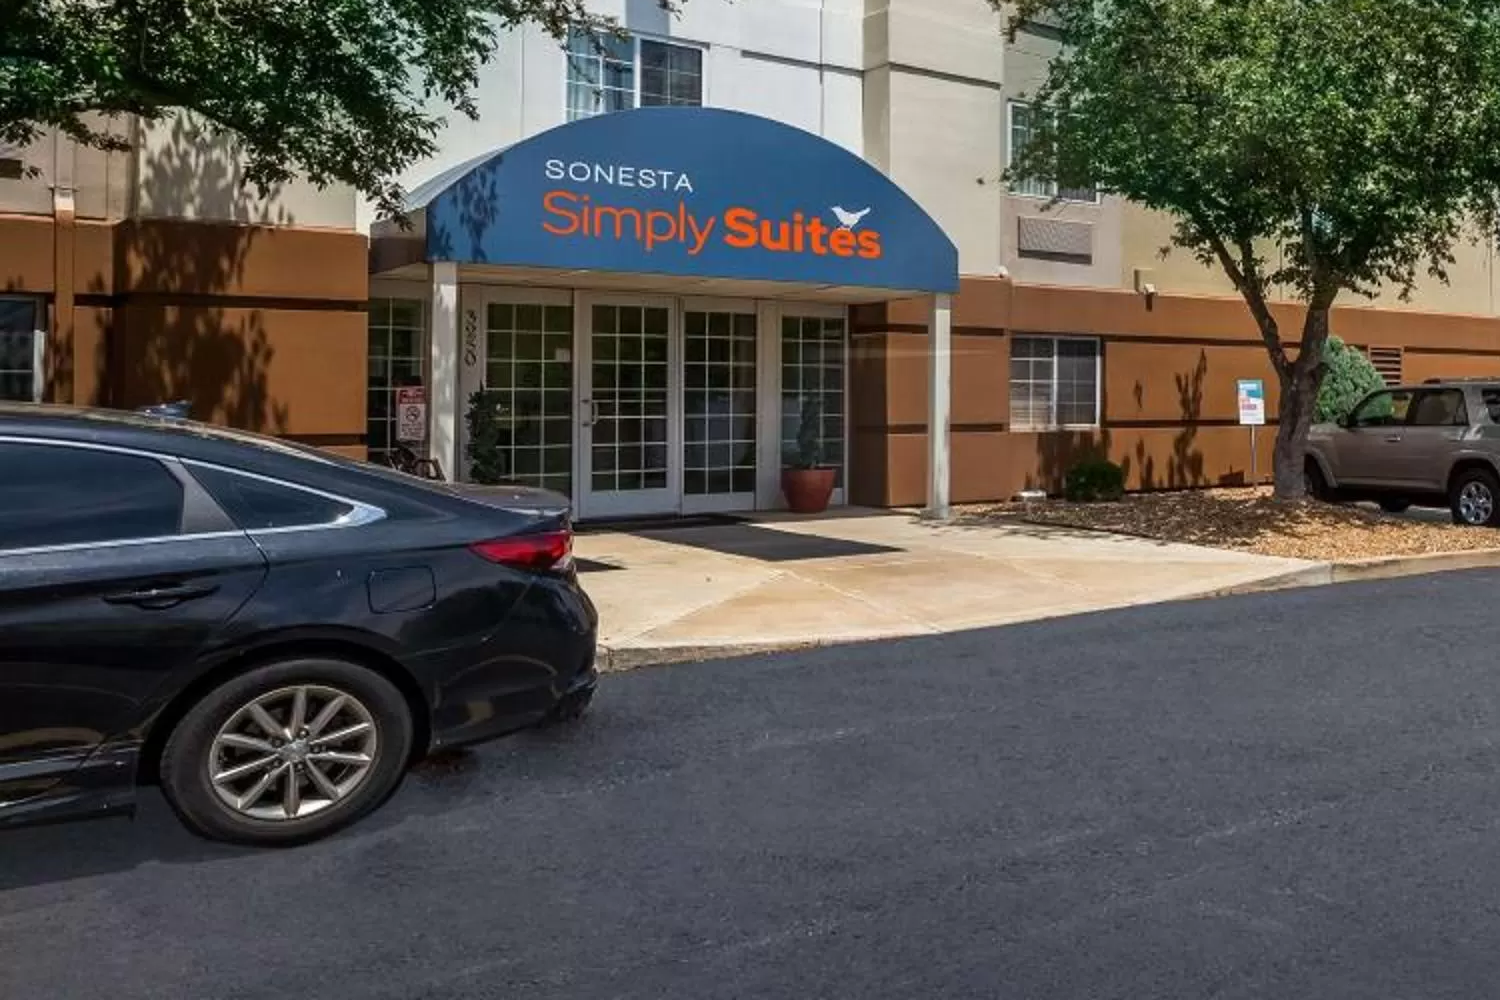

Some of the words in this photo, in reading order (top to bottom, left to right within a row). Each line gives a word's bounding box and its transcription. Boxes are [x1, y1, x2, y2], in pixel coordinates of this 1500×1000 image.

[545, 159, 693, 192] SONESTA
[543, 190, 715, 255] Simply
[724, 207, 881, 259] Suites
